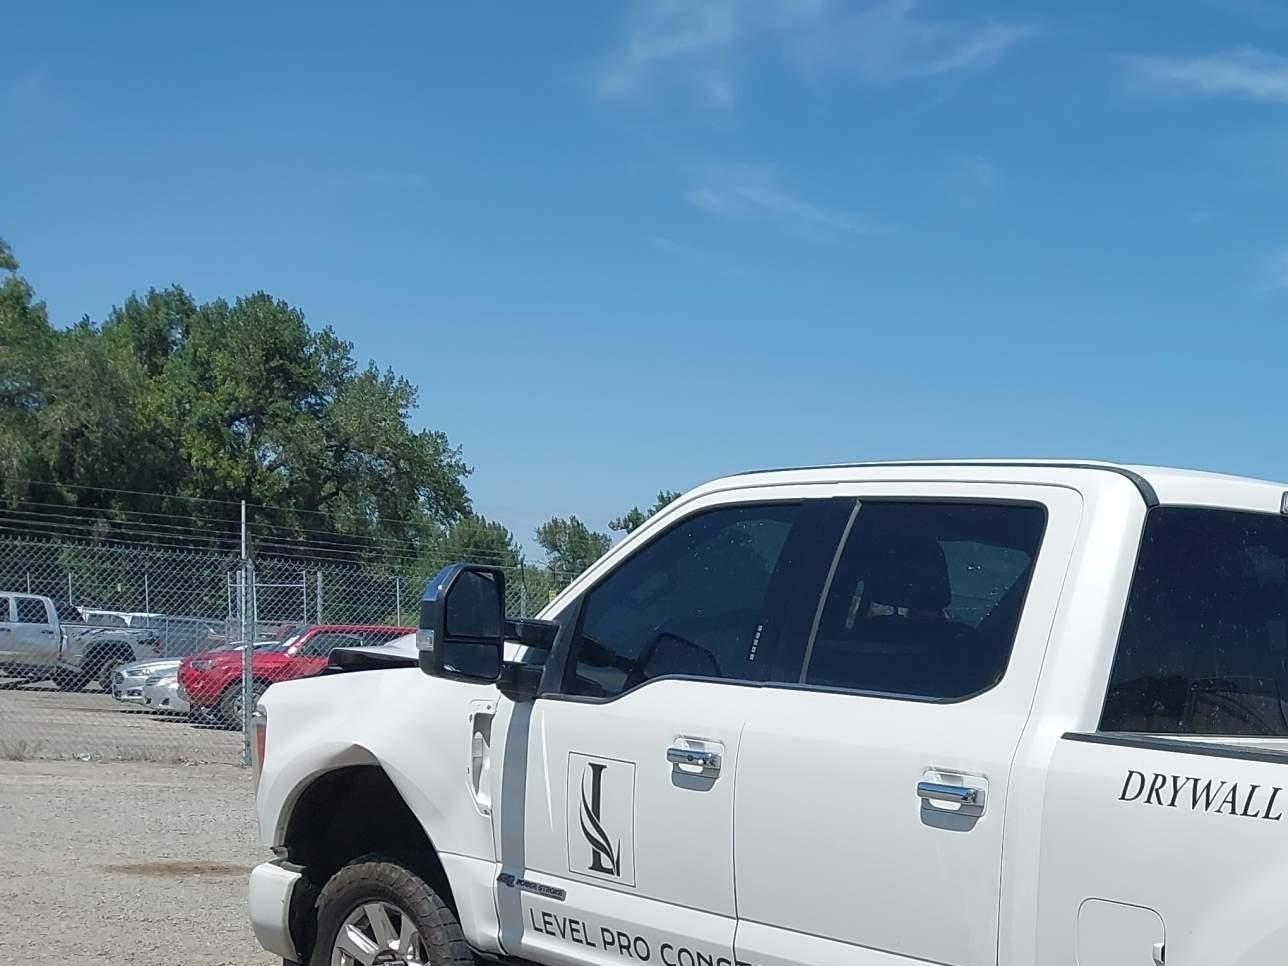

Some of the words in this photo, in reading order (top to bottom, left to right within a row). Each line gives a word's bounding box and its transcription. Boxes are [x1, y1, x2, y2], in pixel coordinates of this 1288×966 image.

[1118, 770, 1283, 821] DRYWALL
[530, 908, 596, 948] LEVEL
[601, 927, 650, 962] PRO
